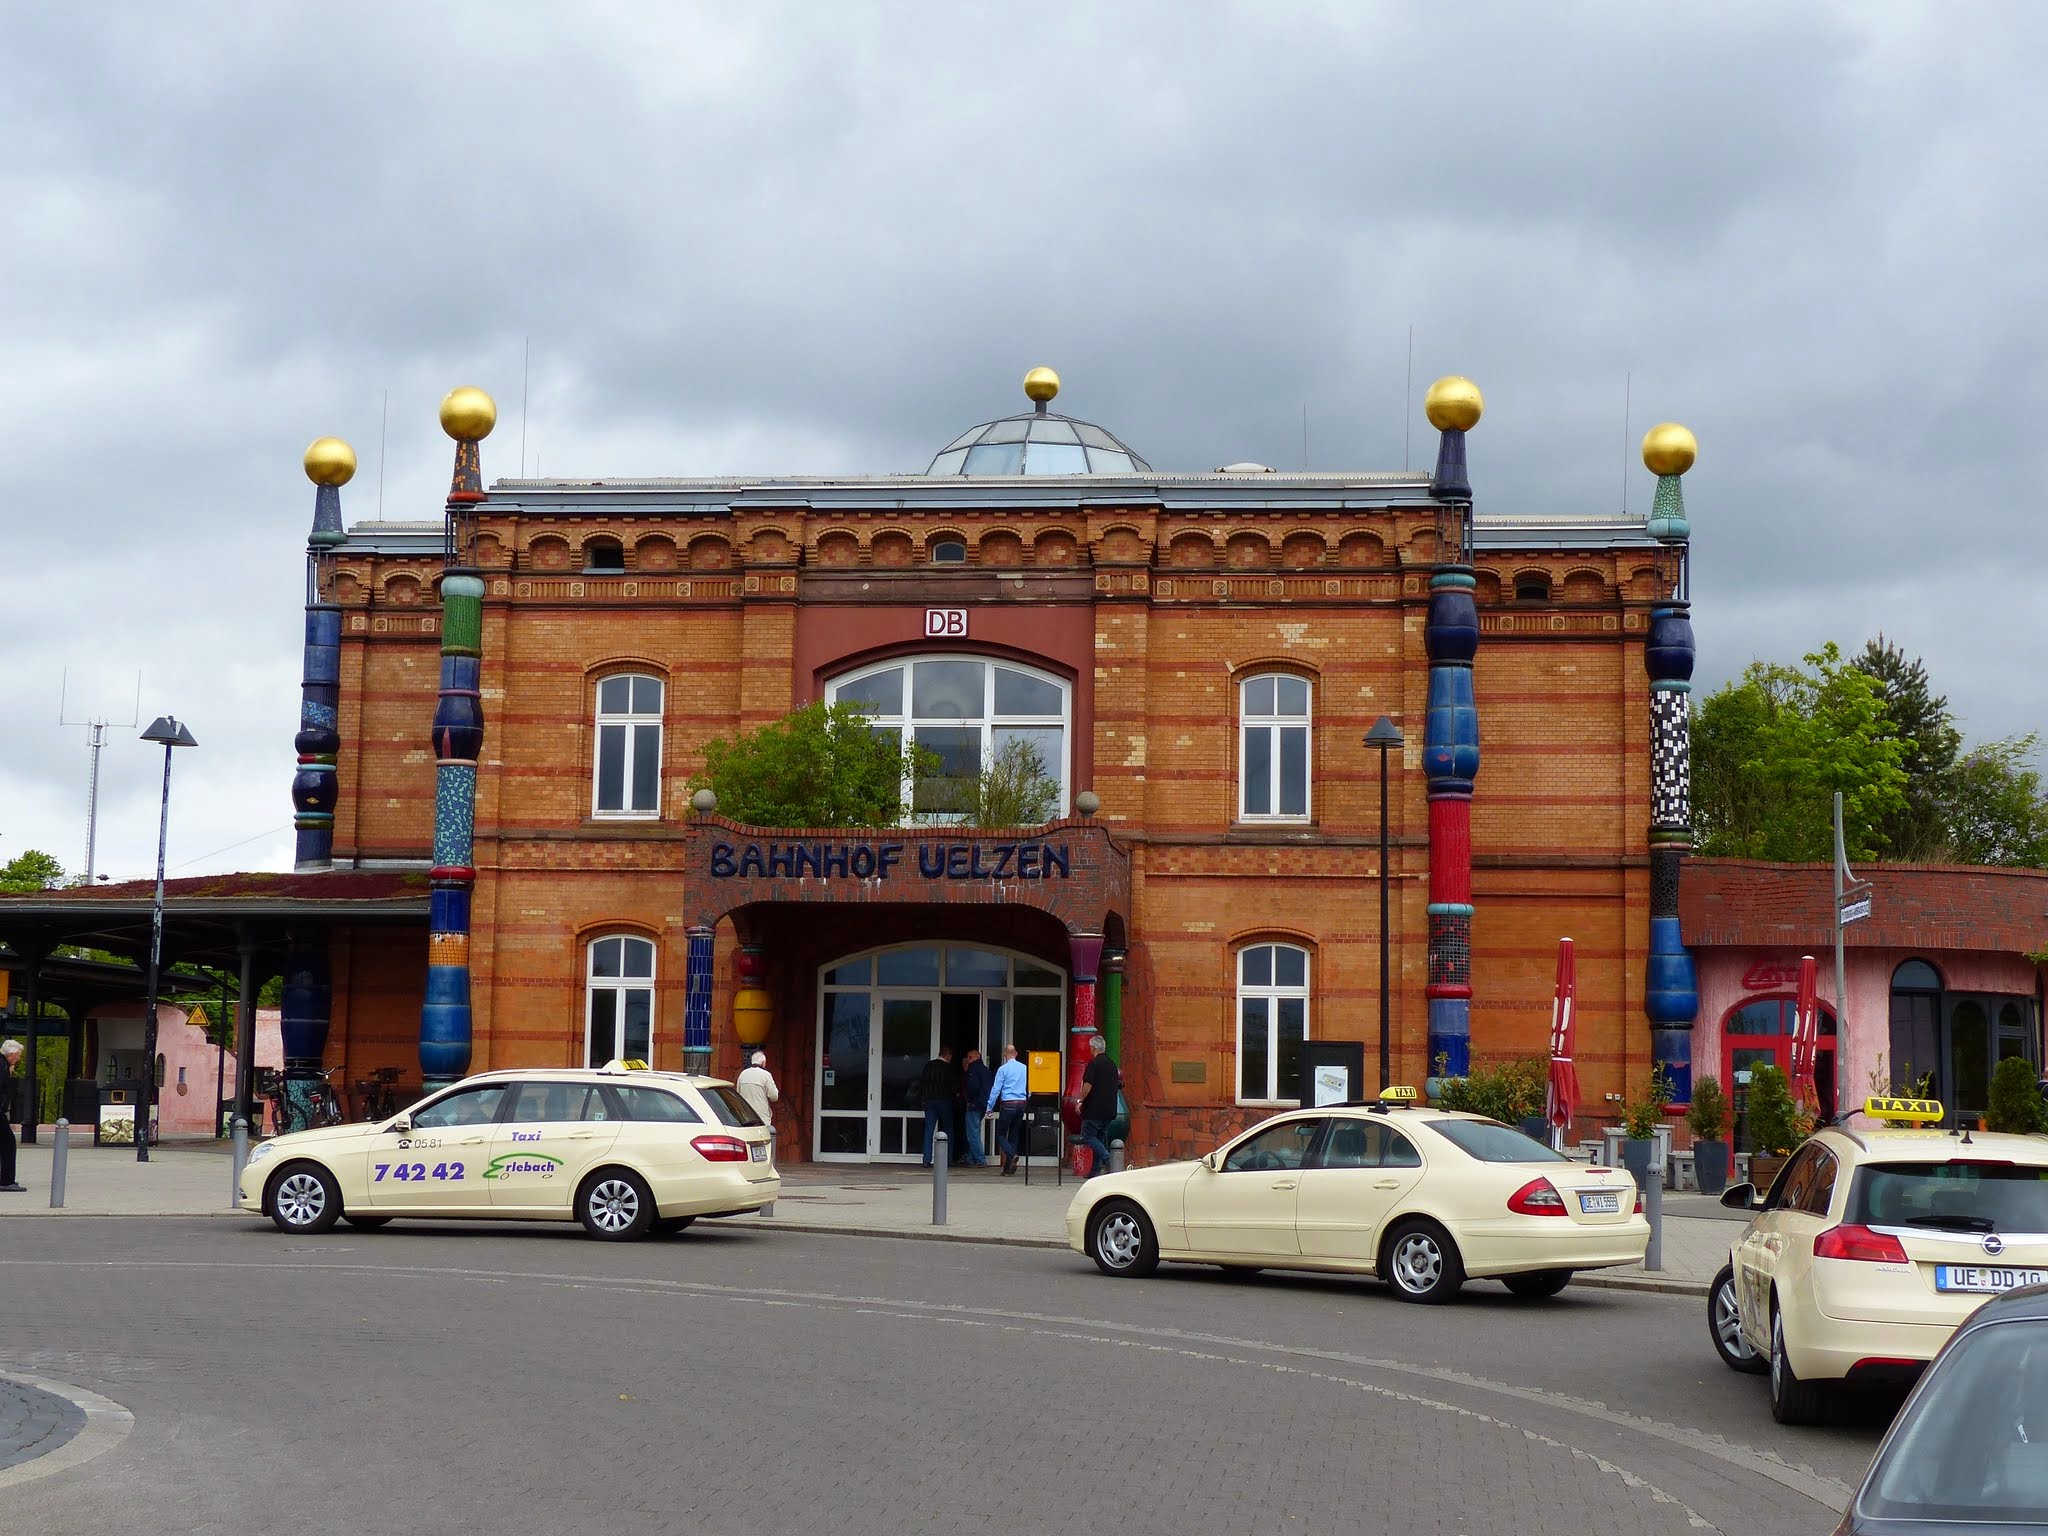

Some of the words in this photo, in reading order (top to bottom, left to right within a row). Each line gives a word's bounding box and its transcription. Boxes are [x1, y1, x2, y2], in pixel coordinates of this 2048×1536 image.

[929, 611, 964, 634] DB
[711, 843, 904, 878] BAHNHOF
[918, 842, 1070, 879] UELZEN
[1395, 1088, 1415, 1097] TAXI
[1878, 1099, 1931, 1112] TAXI
[512, 1130, 541, 1141] Taxi
[482, 1152, 564, 1178] Erlebach
[1954, 1268, 1978, 1286] UE
[1990, 1270, 2014, 1288] DD
